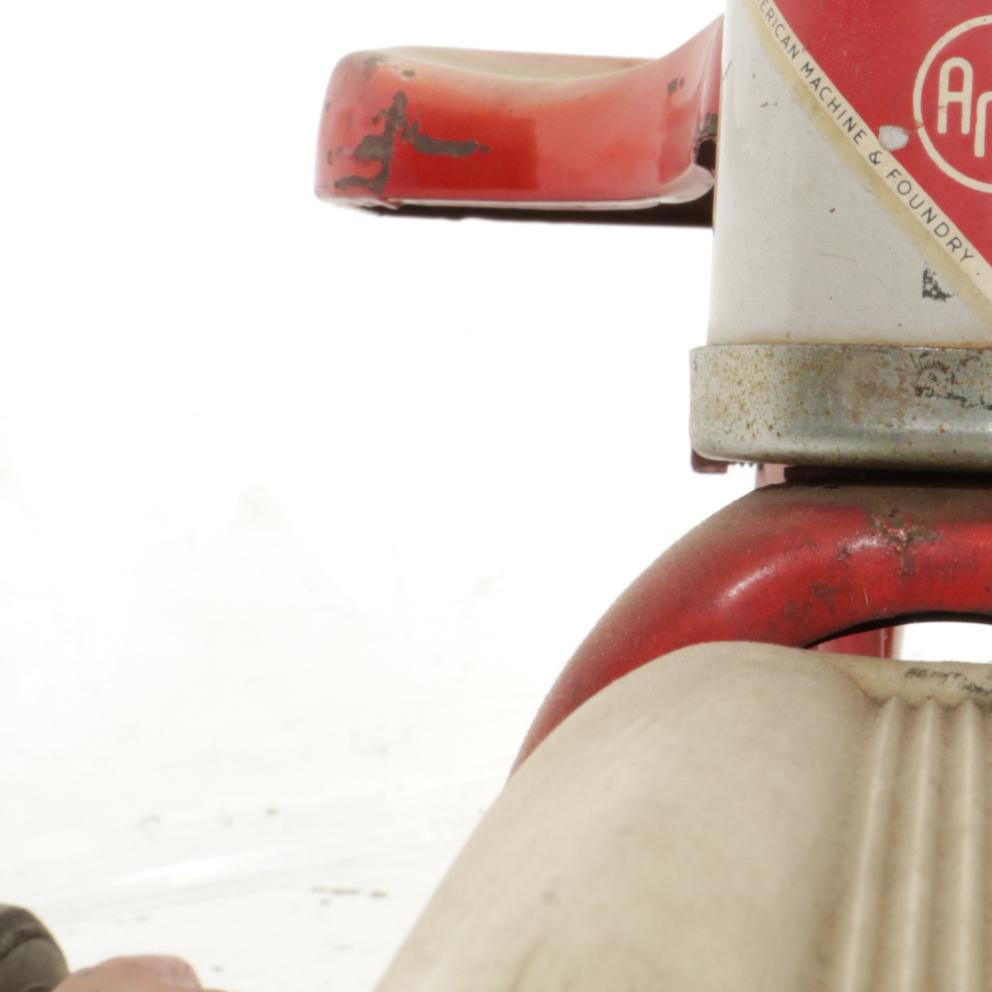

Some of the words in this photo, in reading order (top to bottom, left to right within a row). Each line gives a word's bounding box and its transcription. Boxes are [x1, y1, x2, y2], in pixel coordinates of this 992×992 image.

[800, 62, 869, 146] MACHINE
[867, 150, 882, 166] &
[886, 168, 975, 263] FOUNDRY
